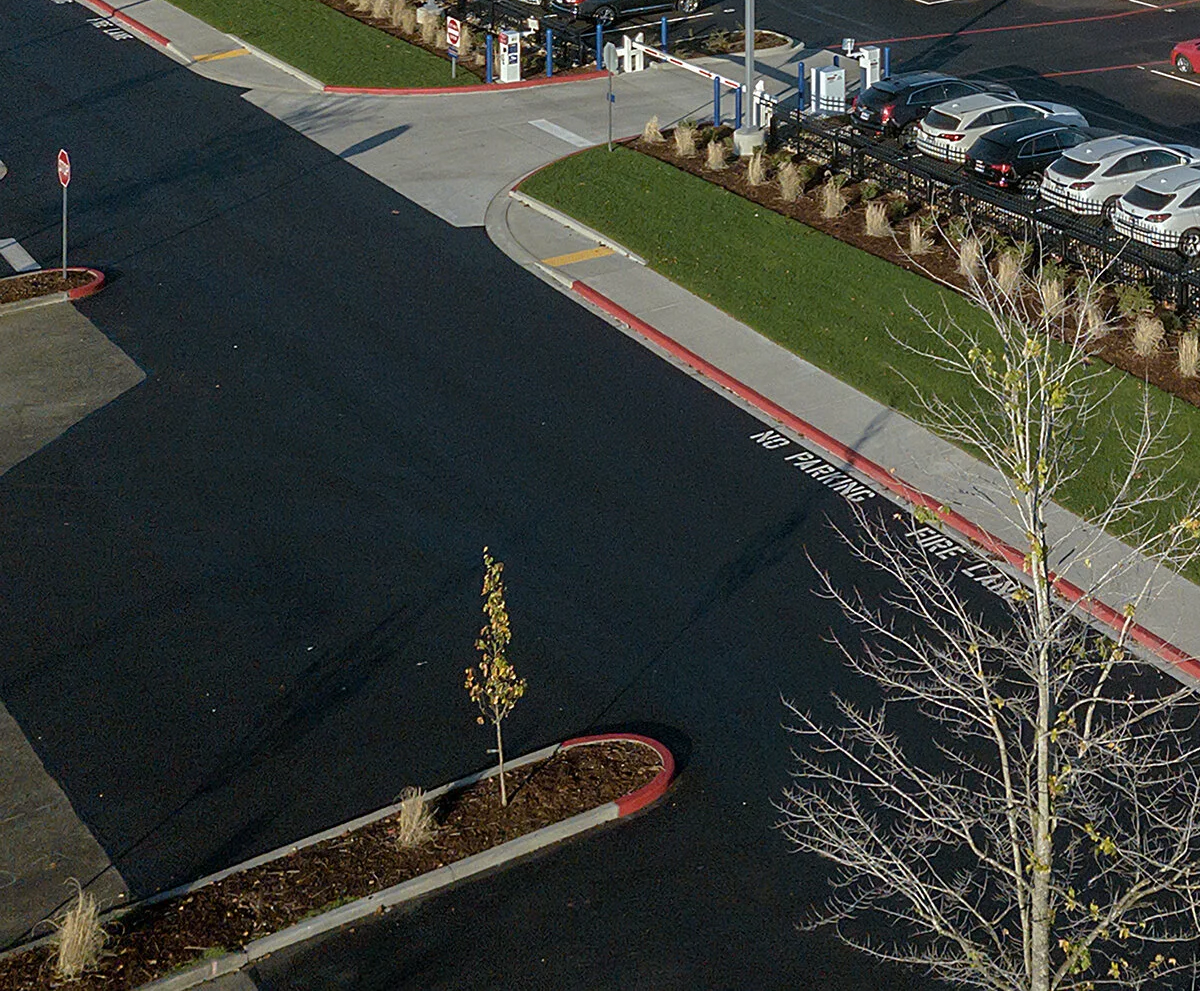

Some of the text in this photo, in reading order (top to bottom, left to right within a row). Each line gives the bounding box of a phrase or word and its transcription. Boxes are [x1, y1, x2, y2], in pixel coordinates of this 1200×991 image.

[750, 430, 1034, 605] NO PARKING FIRE LAN
